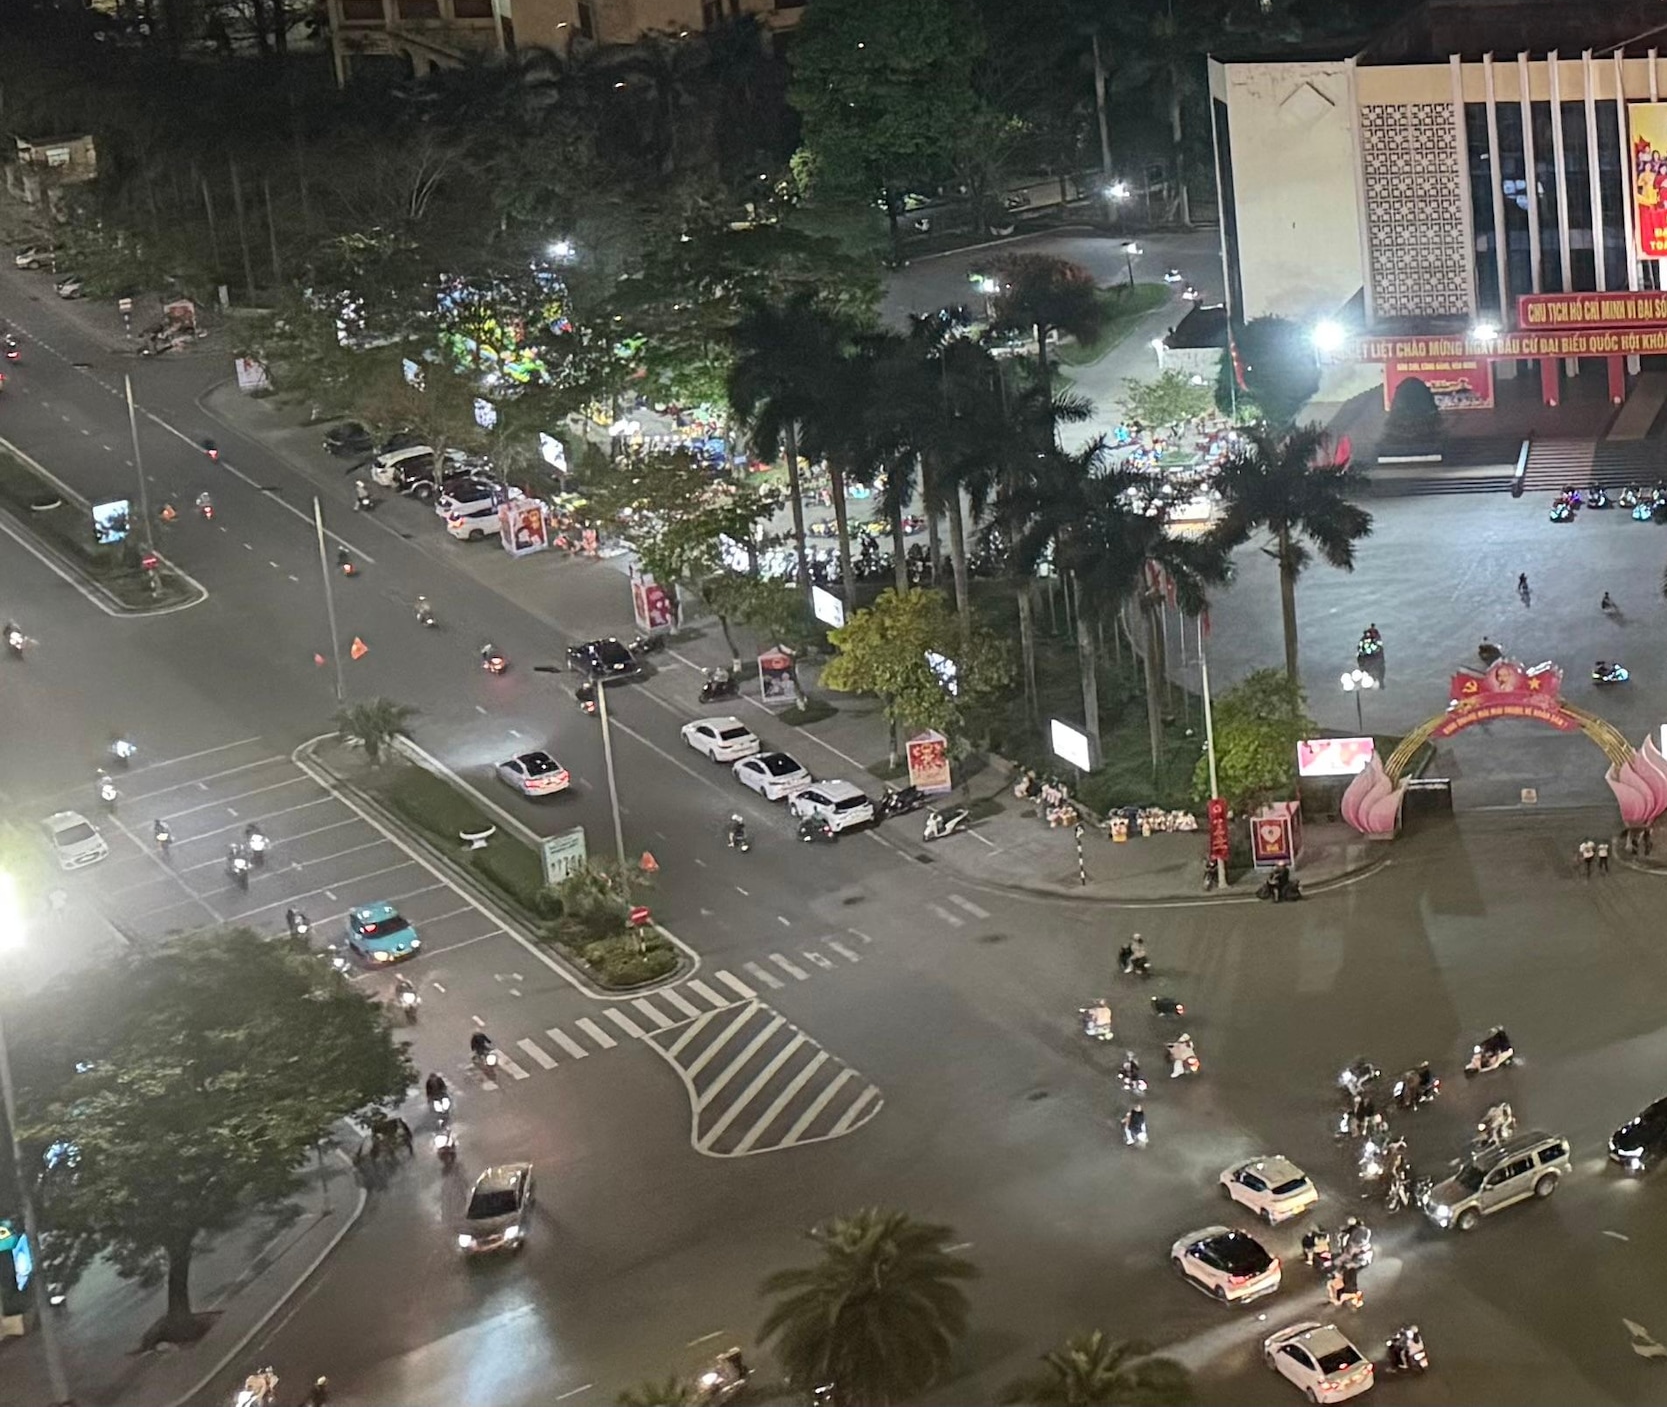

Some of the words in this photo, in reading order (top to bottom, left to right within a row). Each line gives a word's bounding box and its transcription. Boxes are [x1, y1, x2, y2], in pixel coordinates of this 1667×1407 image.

[1547, 301, 1569, 325] TỊCH
[1569, 296, 1583, 321] HỒ
[1584, 296, 1600, 320] CHÍ
[1601, 299, 1626, 320] MINH
[1626, 295, 1636, 319] VÌ
[1637, 298, 1653, 320] ĐẠI
[1396, 338, 1426, 358] CHÀO
[1429, 338, 1462, 356] MỪNG
[1522, 334, 1538, 353] CỬ
[1540, 337, 1559, 356] ĐẠI
[1589, 331, 1618, 353] QUỐC
[1621, 331, 1639, 353] HỘI
